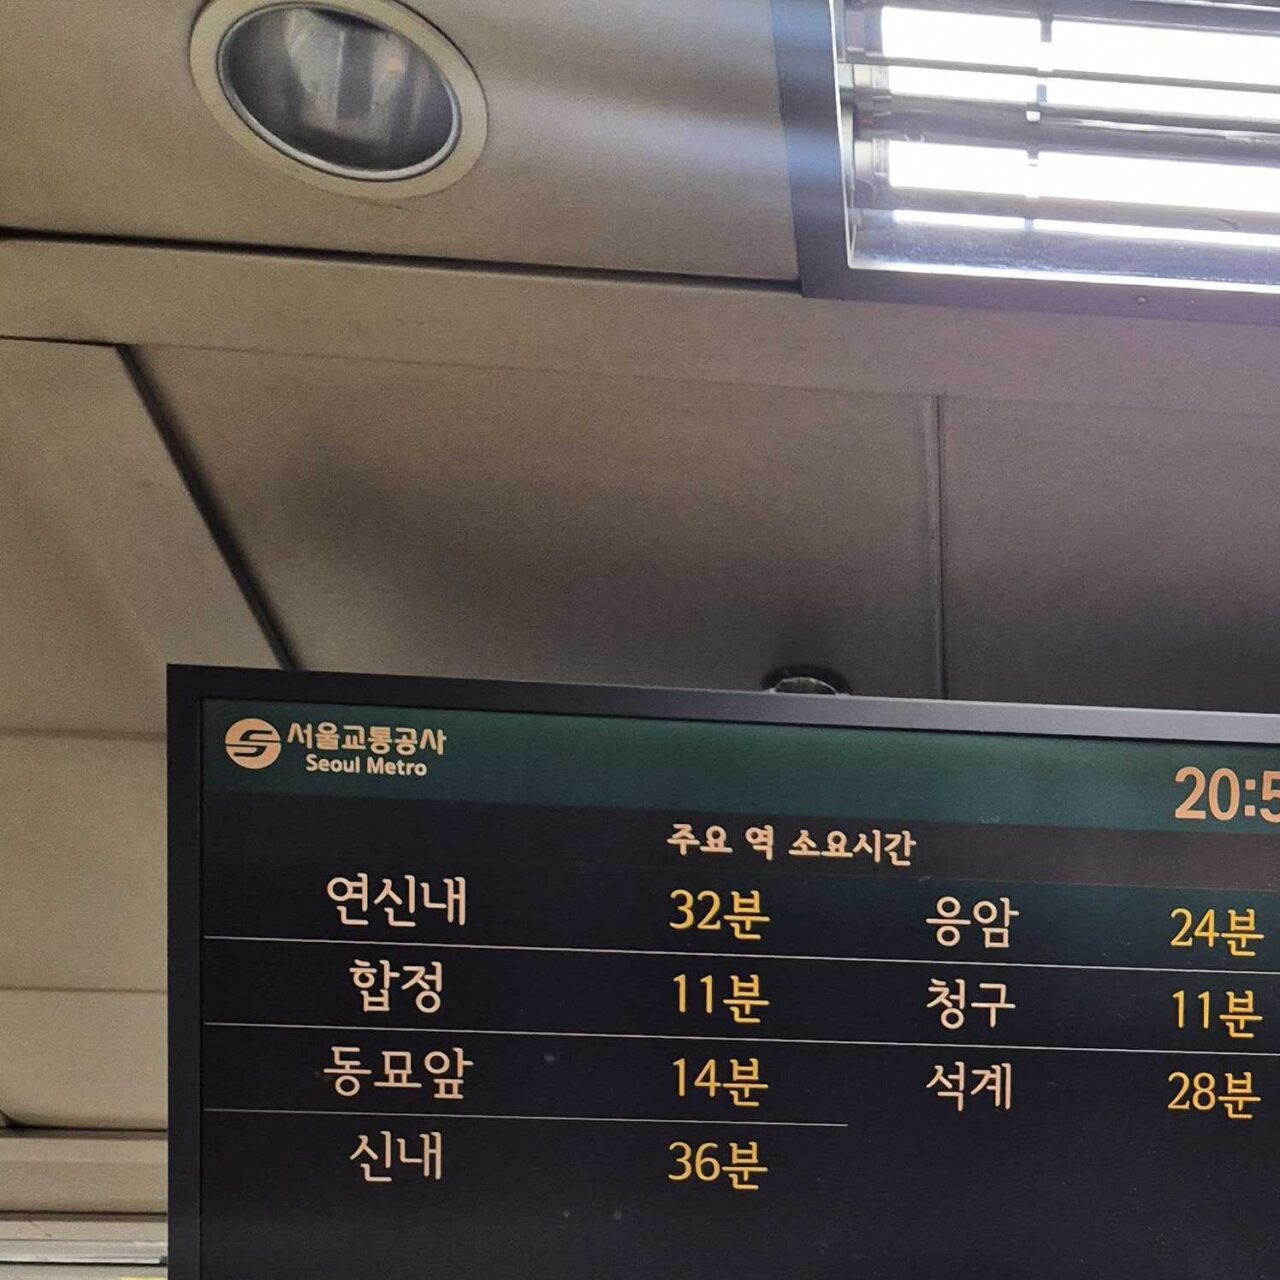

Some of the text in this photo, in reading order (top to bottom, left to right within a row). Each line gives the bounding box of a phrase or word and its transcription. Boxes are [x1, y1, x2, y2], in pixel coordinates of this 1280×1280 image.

[286, 723, 447, 755] 서울교통공사
[305, 754, 427, 777] Seoul Metro
[666, 824, 917, 867] 주요 역 소요시간
[326, 873, 770, 940] 연신내 32분
[925, 897, 1264, 956] 응암 24분
[349, 959, 769, 1023] 합정 11분
[926, 978, 1263, 1038] 청구 11분
[323, 1047, 768, 1106] 동묘앞 14분
[926, 1061, 1262, 1119] 석계 28분
[349, 1131, 768, 1190] 신내 36분
